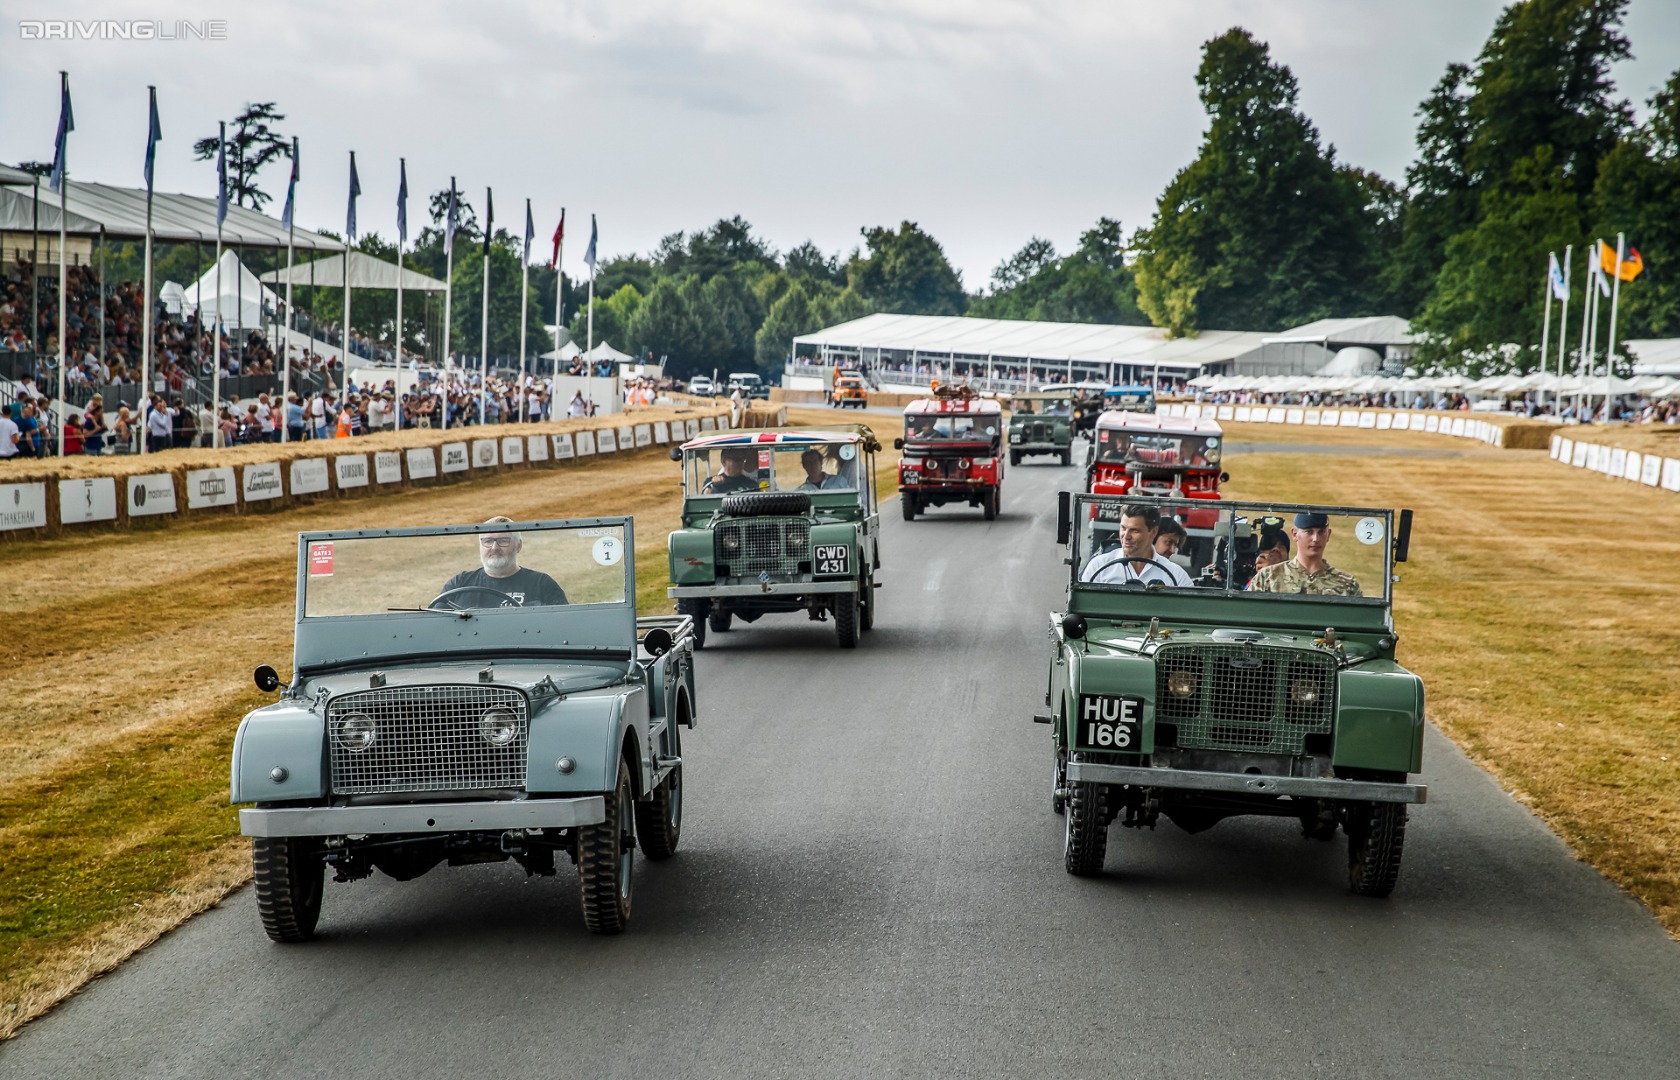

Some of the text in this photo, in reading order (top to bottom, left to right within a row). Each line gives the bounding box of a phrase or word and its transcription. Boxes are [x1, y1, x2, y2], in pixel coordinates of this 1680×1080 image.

[340, 463, 365, 480] SAMSUNG
[200, 479, 226, 496] MARTINI
[0, 510, 35, 526] THAKEHAM
[1366, 531, 1373, 540] 2
[604, 551, 611, 561] 1
[816, 546, 847, 560] GWD
[820, 559, 844, 573] 431
[1084, 697, 1138, 723] HUE
[1088, 722, 1131, 747] 166
